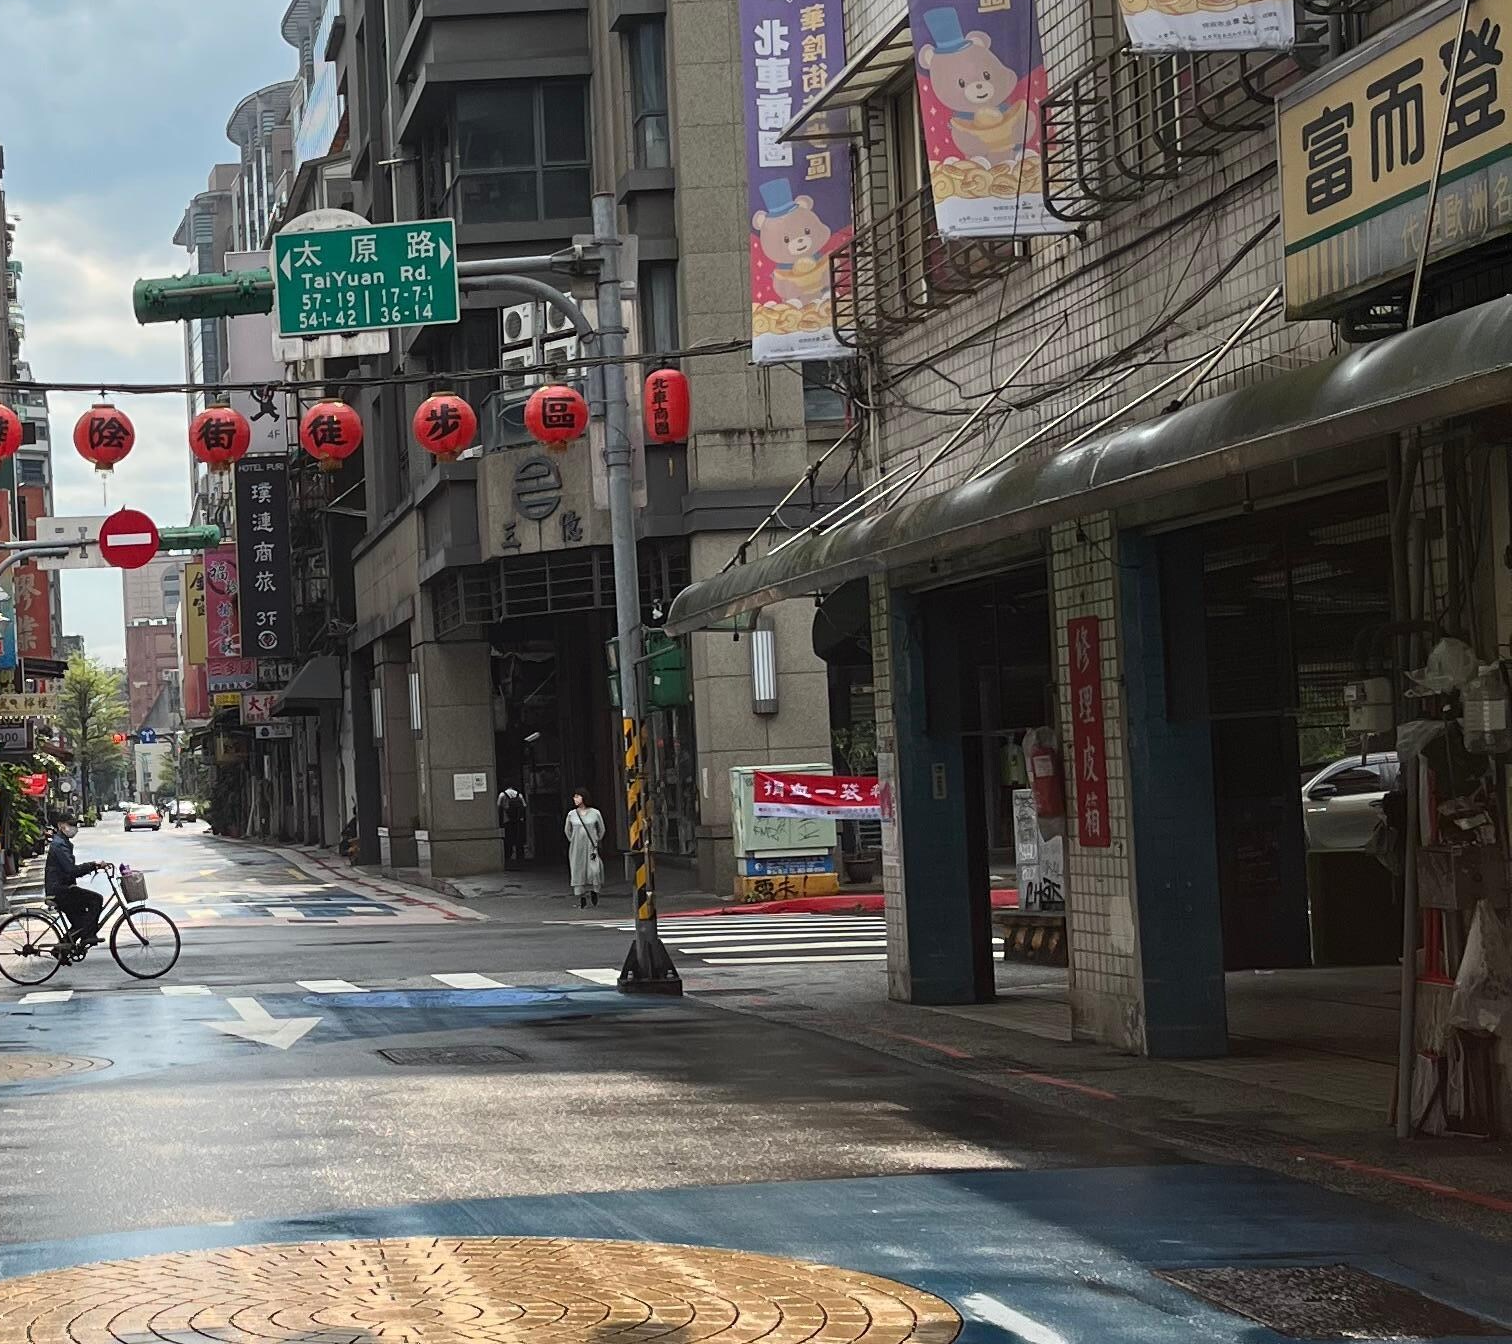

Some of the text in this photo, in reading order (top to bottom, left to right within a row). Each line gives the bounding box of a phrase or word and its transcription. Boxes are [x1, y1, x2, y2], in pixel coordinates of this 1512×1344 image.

[1301, 17, 1506, 216] 富而登
[293, 230, 436, 268] 太原路
[301, 265, 432, 289] TaiYuan Rd.
[89, 416, 131, 451] 陰
[197, 417, 237, 451] 街
[307, 414, 348, 448] 徒
[425, 403, 463, 442] 步
[540, 396, 577, 429] 區
[256, 610, 278, 627] 3F
[1074, 624, 1101, 838] 修理皮箱
